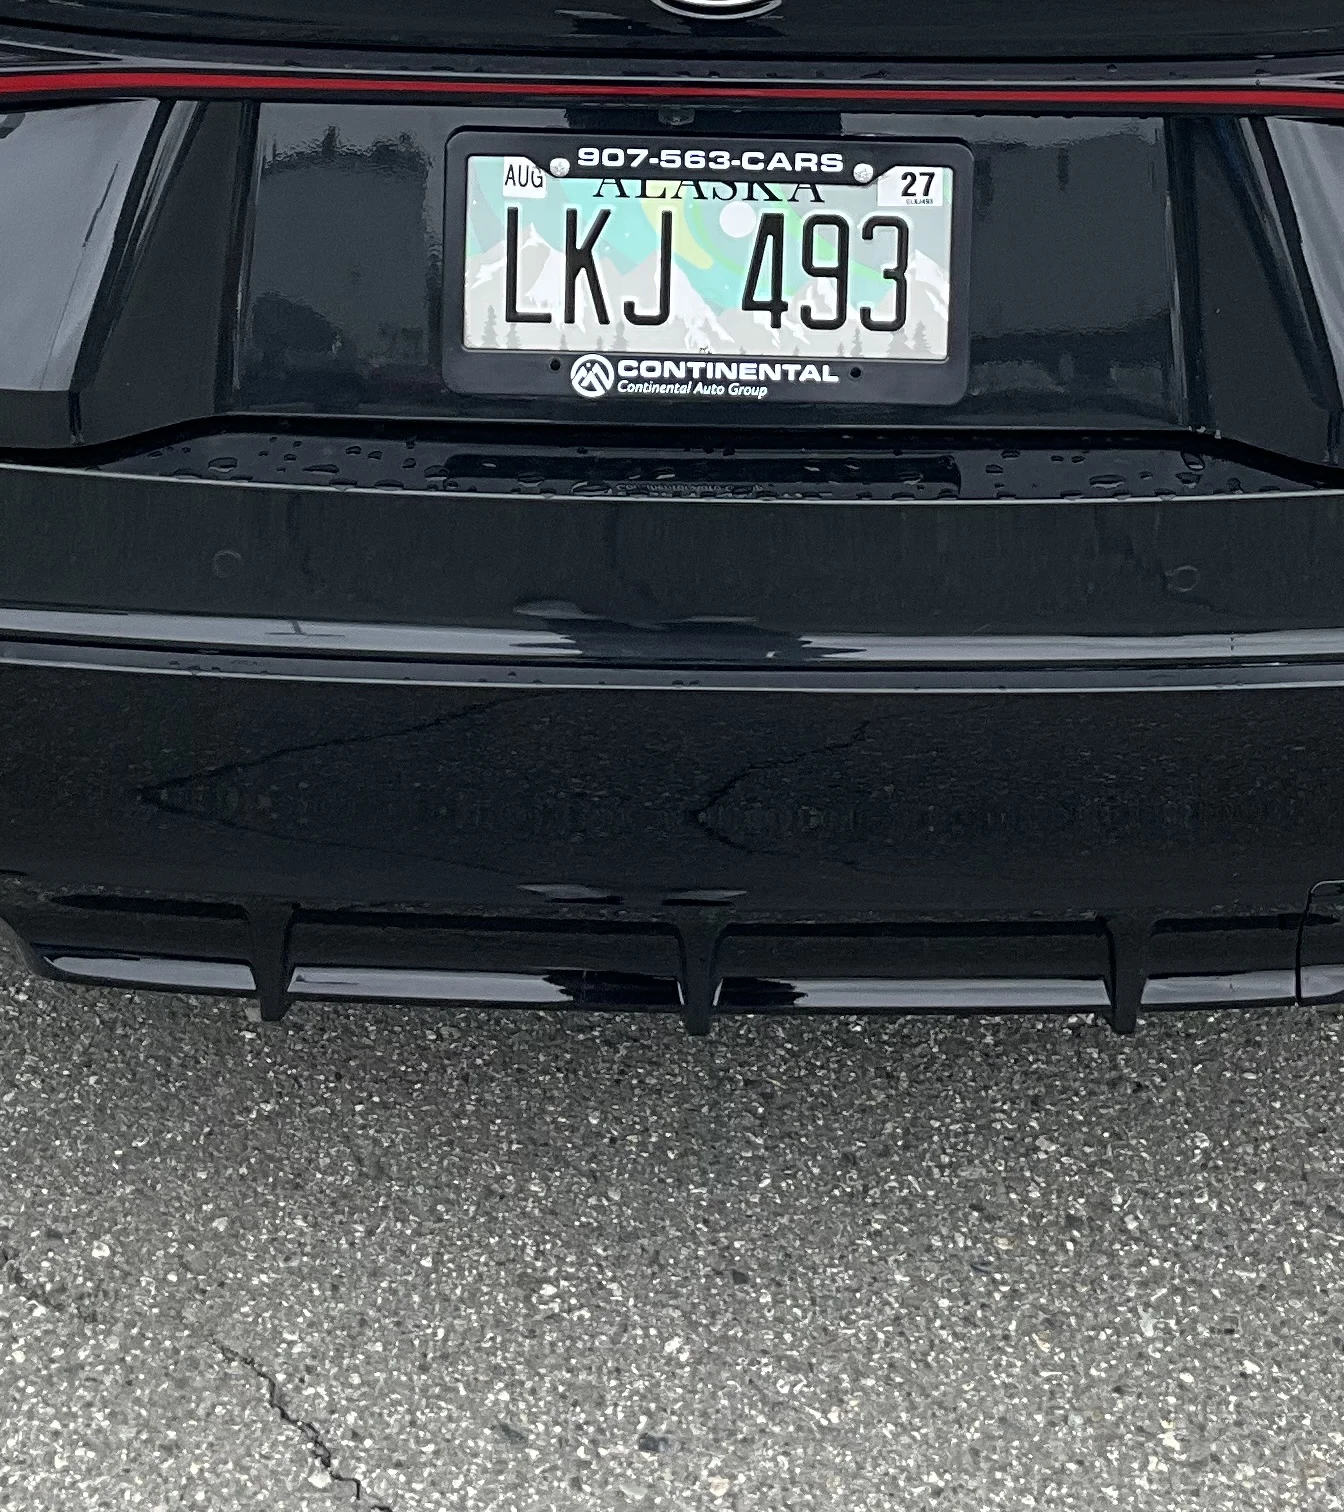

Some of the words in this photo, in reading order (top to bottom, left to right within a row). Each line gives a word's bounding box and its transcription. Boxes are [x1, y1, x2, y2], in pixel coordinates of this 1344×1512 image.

[577, 147, 844, 173] 907-563-CARS
[504, 164, 544, 189] AUG
[901, 171, 935, 197] 27
[505, 206, 673, 327] LKJ
[741, 212, 910, 333] 493
[617, 359, 840, 383] CONTINENTAL
[617, 380, 691, 395] Continental
[692, 382, 725, 396] Auto
[728, 383, 768, 400] Group
